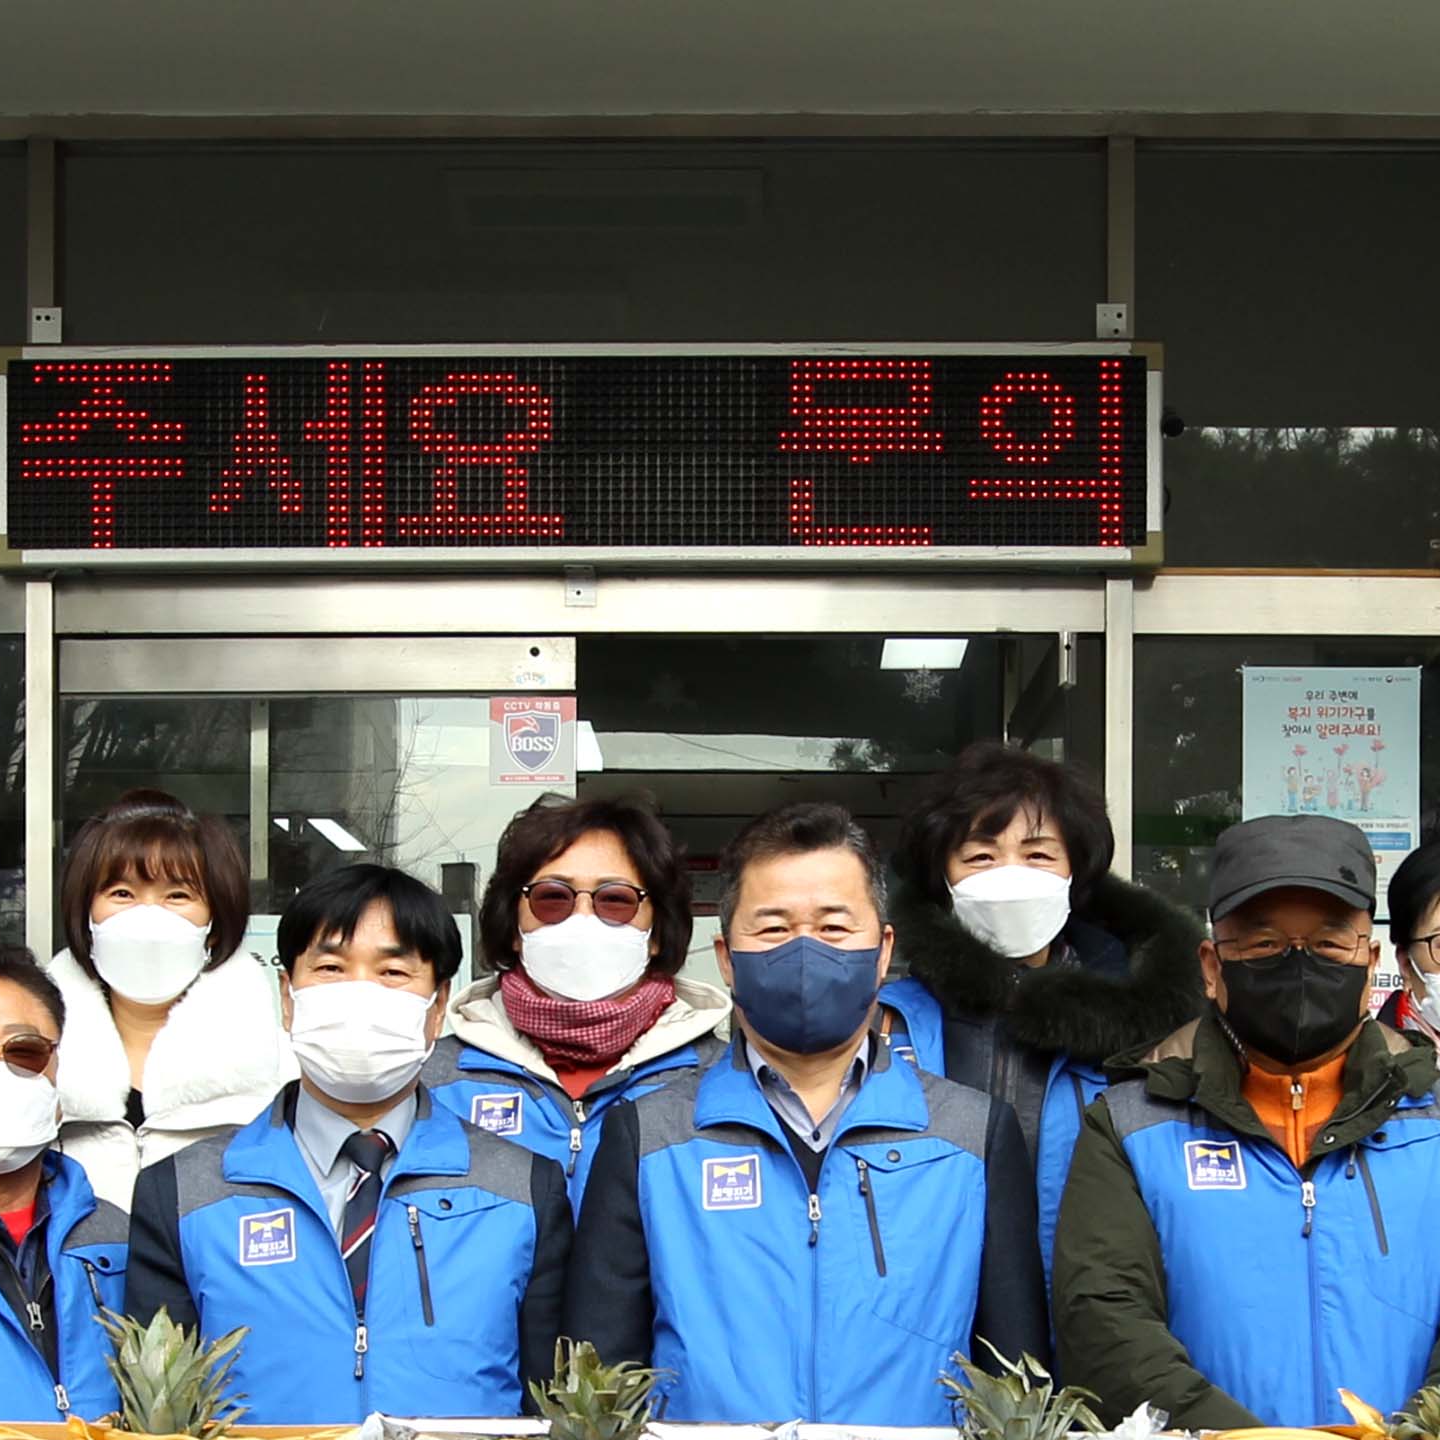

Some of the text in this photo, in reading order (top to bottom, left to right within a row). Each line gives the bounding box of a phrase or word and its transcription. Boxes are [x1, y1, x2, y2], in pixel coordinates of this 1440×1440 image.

[21, 361, 1124, 548] 주세요 문의
[1304, 690, 1359, 703] 우리 주변에
[504, 702, 537, 712] CCTV
[1287, 704, 1376, 722] 복지 위기가구를
[1316, 723, 1382, 739] 알려주세요!
[512, 736, 556, 754] BOSS
